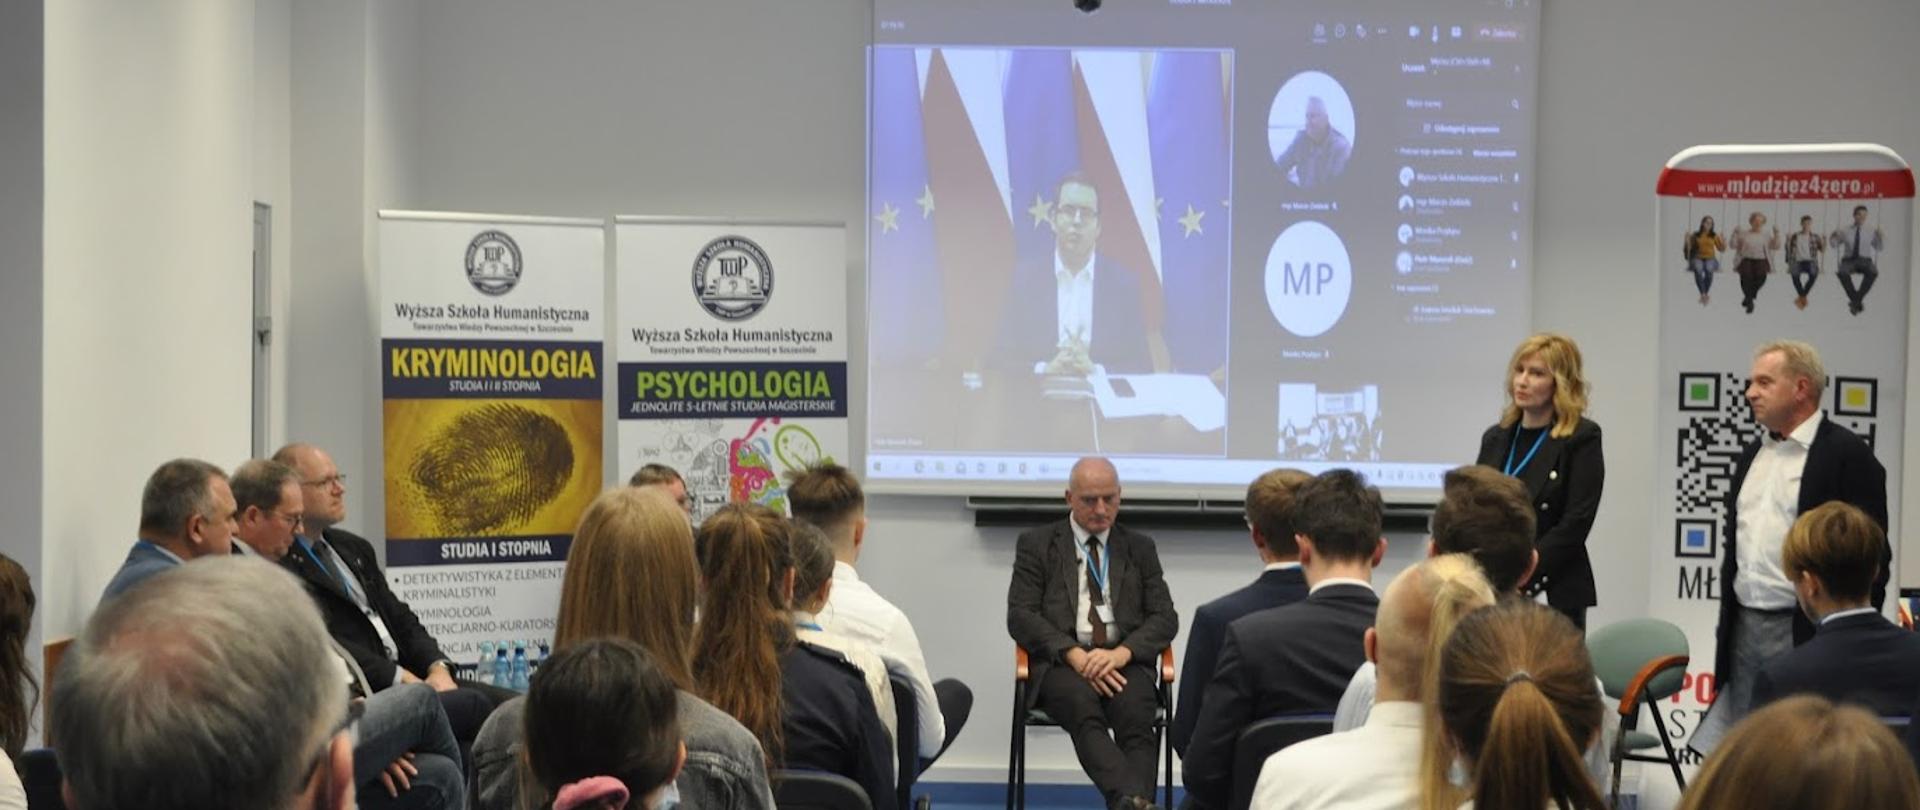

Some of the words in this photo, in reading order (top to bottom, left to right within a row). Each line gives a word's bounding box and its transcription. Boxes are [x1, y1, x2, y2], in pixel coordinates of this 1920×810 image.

[1283, 261, 1334, 296] MP
[395, 303, 444, 321] Wyższa
[447, 304, 490, 319] Szkoła
[494, 305, 590, 323] Humanistyczna
[632, 328, 681, 344] Wyższa
[684, 327, 728, 342] Szkoła
[732, 328, 833, 345] Humanistyczna
[391, 347, 596, 379] KRYMINOLOGIA
[449, 380, 483, 392] STUDIA
[502, 380, 542, 392] STOPNIA
[637, 370, 831, 399] PSYCHOLOGIA
[630, 400, 684, 413] JEDNOLITE
[686, 401, 729, 412] 5-LETNIE
[731, 400, 767, 412] STUDIA
[768, 399, 836, 412] MAGISTERSKIE
[441, 542, 489, 559] STUDIA
[491, 543, 496, 557] I
[499, 540, 552, 557] STOPNIA
[403, 570, 502, 585] DETEKTYWISTYKA
[504, 570, 513, 581] Z
[403, 586, 496, 602] KRYMINALISTYKI
